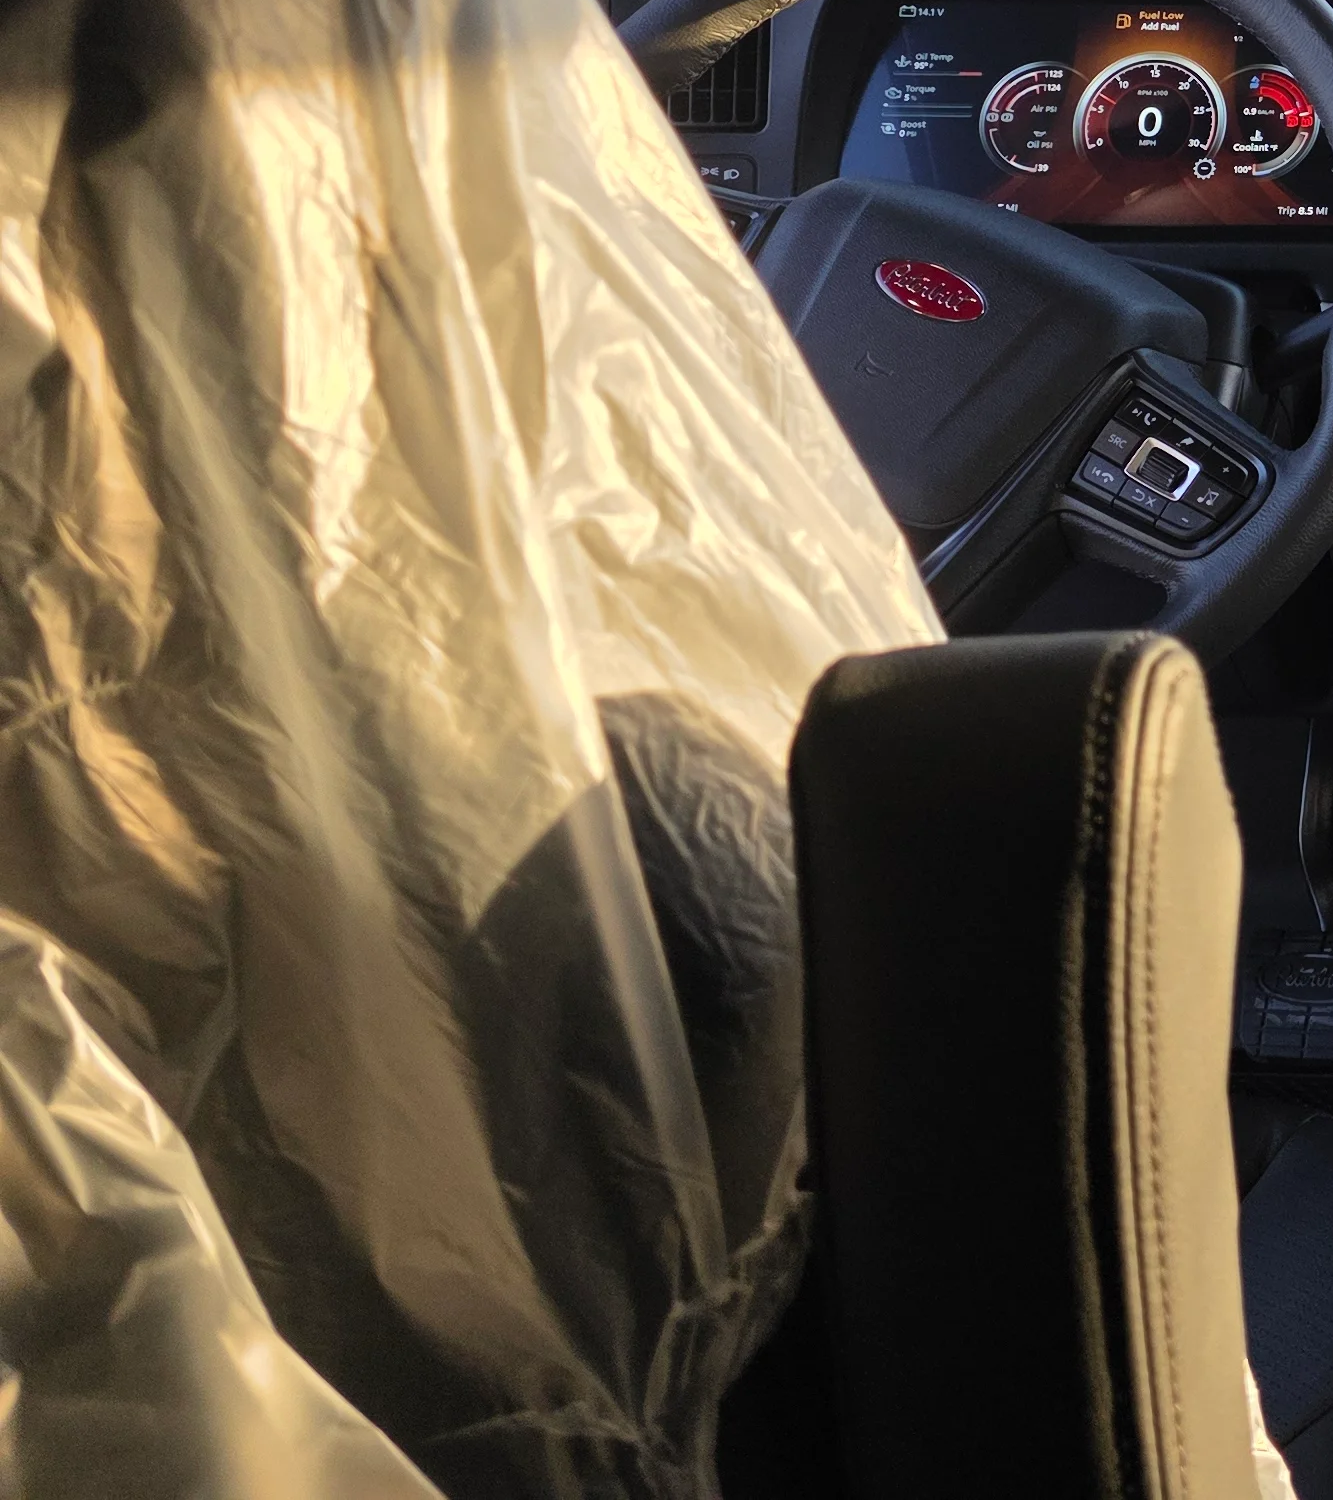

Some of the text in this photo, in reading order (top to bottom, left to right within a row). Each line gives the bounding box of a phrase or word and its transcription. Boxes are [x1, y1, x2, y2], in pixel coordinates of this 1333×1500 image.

[918, 8, 945, 17] 14.1 V
[1138, 10, 1185, 20] Fuel Low
[1140, 22, 1180, 32] Add Fuel
[915, 52, 954, 63] Oil Temp
[1149, 69, 1161, 78] 15
[1118, 80, 1130, 89] 10
[1177, 81, 1190, 90] 20
[905, 84, 936, 95] Torque
[904, 93, 910, 102] 5
[1030, 104, 1058, 113] Air PSI
[1097, 106, 1104, 114] 5
[1193, 106, 1206, 115] 25
[900, 120, 927, 129] Boost
[1138, 106, 1163, 138] 0
[898, 129, 918, 138] 0 PSI
[1026, 140, 1054, 150] Oil PSI
[1096, 138, 1104, 147] 0
[1138, 139, 1157, 147] MPH
[1187, 139, 1201, 148] 30
[1232, 143, 1269, 152] Coolant
[1277, 206, 1329, 217] Trip 8.5 MI
[1107, 432, 1129, 451] SRC
